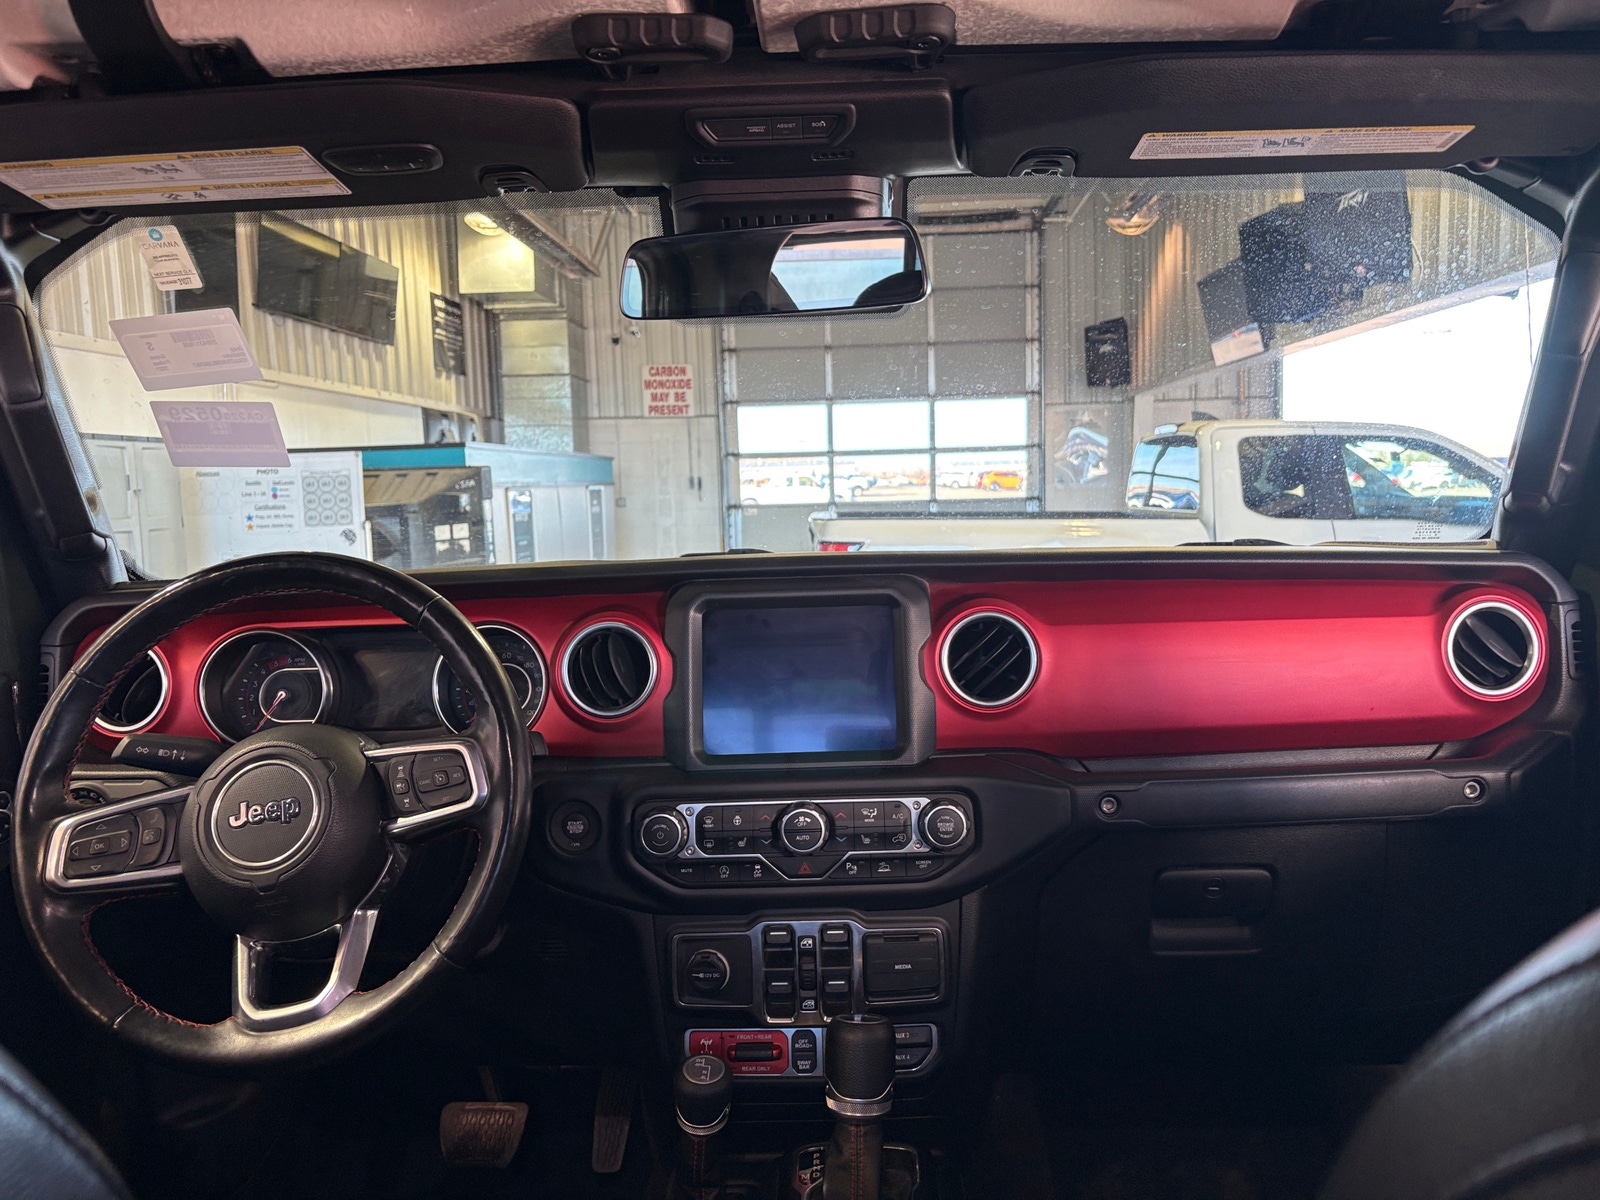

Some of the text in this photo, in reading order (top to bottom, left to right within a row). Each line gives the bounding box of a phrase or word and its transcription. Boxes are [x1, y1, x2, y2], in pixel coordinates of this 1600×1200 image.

[142, 241, 179, 250] CARVANA
[648, 366, 686, 377] CARBON
[644, 379, 692, 390] MONOXIDE
[651, 392, 686, 402] MAY BE
[648, 405, 689, 415] PRESENT
[228, 797, 301, 829] Jeep
